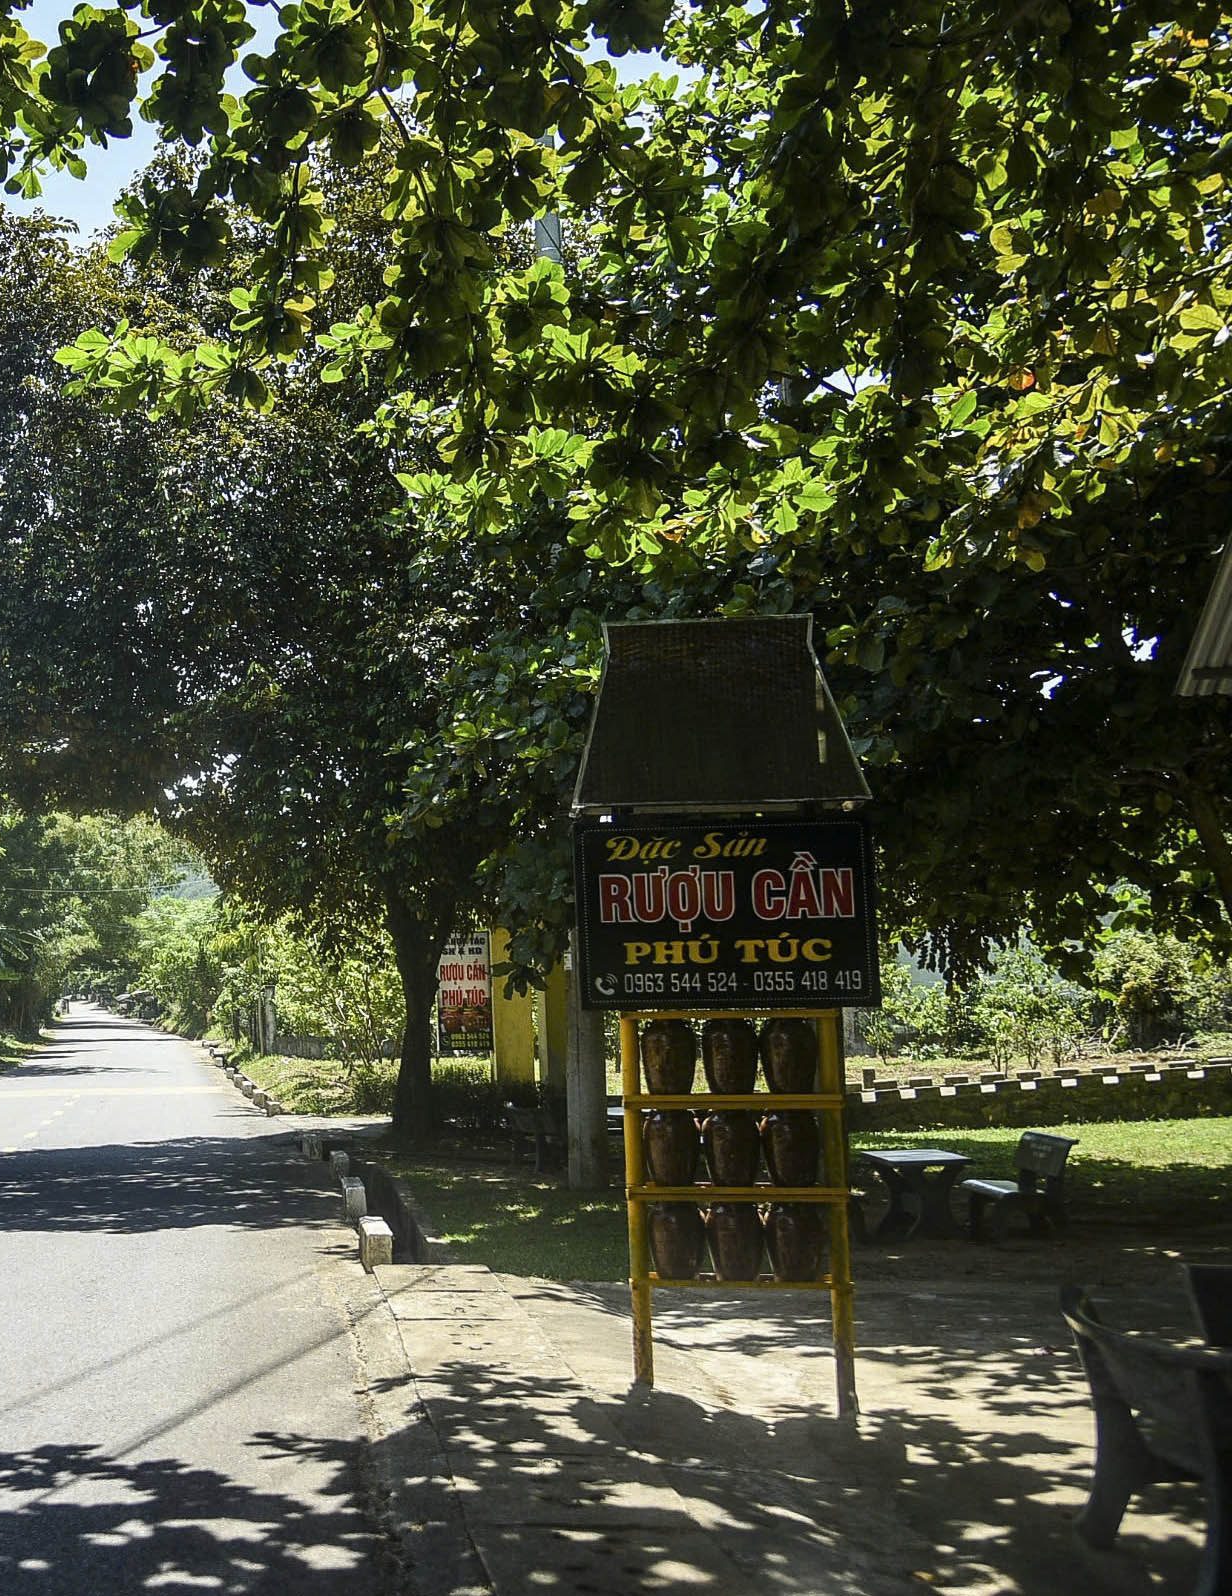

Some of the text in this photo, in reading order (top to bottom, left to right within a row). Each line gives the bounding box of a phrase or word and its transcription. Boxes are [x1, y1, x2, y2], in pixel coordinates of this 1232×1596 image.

[606, 831, 767, 865] Đặc Sản
[599, 851, 855, 933] RƯỢU CẦN
[623, 932, 833, 966] PHÚ TÚC
[440, 963, 464, 985] RƯỢU
[624, 973, 664, 993] 0963
[670, 973, 702, 992] 544
[707, 972, 737, 992] 524
[753, 971, 795, 991] 0355
[801, 970, 828, 990] 418
[834, 970, 862, 990] 419
[442, 985, 486, 1006] PHÚ TÚC
